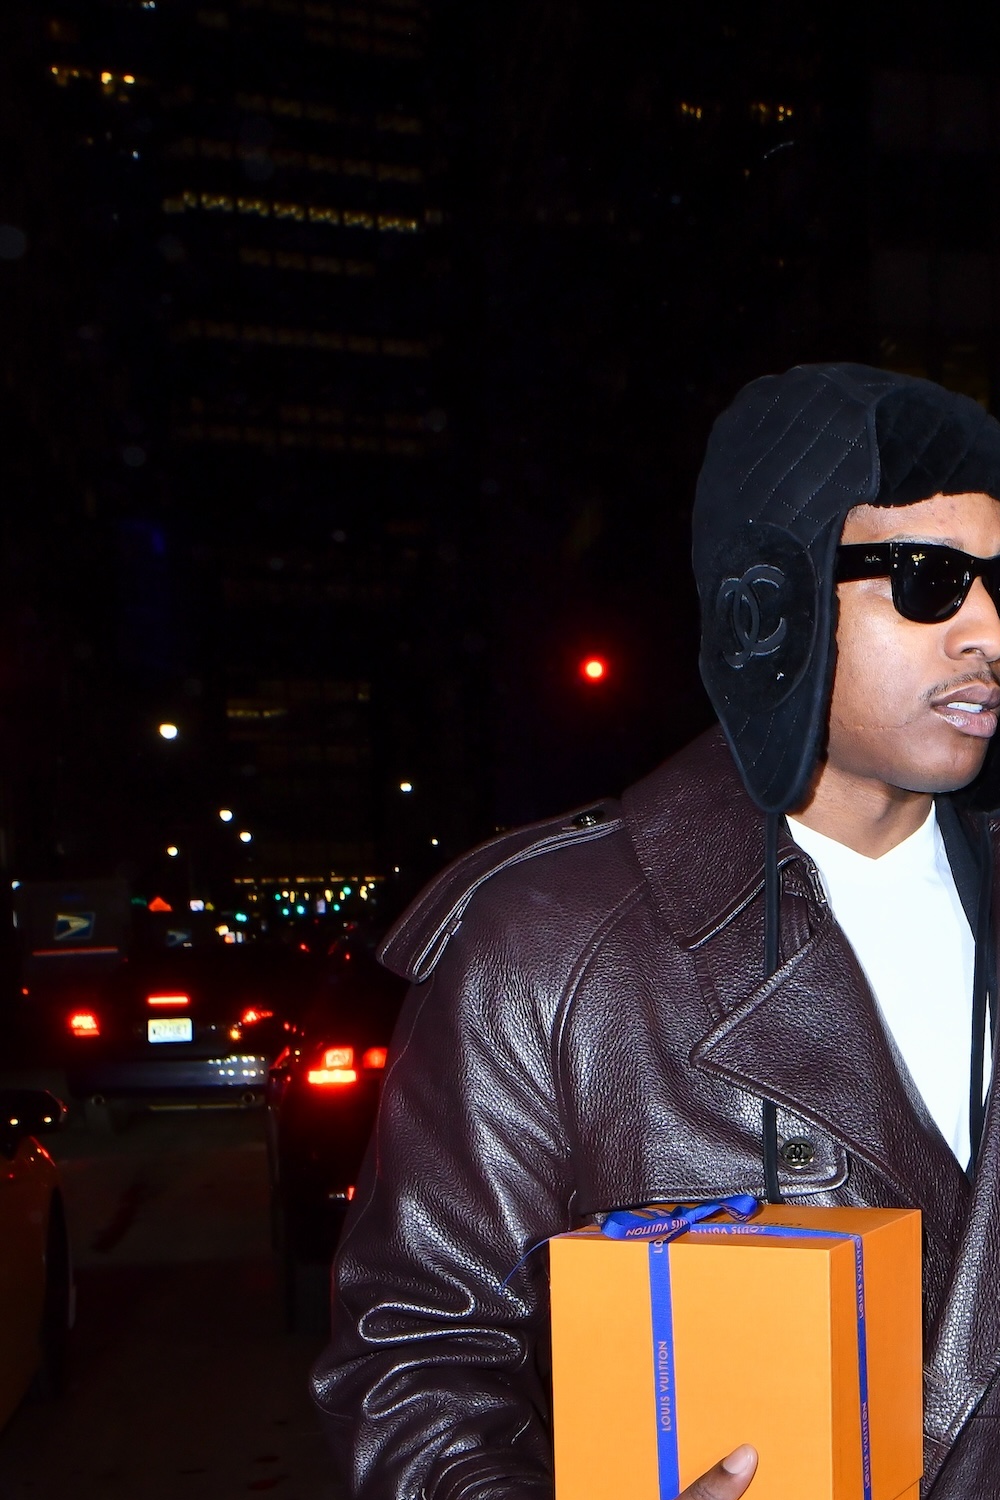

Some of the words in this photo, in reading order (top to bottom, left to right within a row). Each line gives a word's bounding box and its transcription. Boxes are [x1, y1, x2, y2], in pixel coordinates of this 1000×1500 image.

[625, 1222, 669, 1237] VUITTON
[658, 1341, 669, 1392] VUITTON
[660, 1396, 671, 1431] LOUIS
[861, 1402, 869, 1453] VUITTON
[863, 1454, 871, 1489] LOUIS
